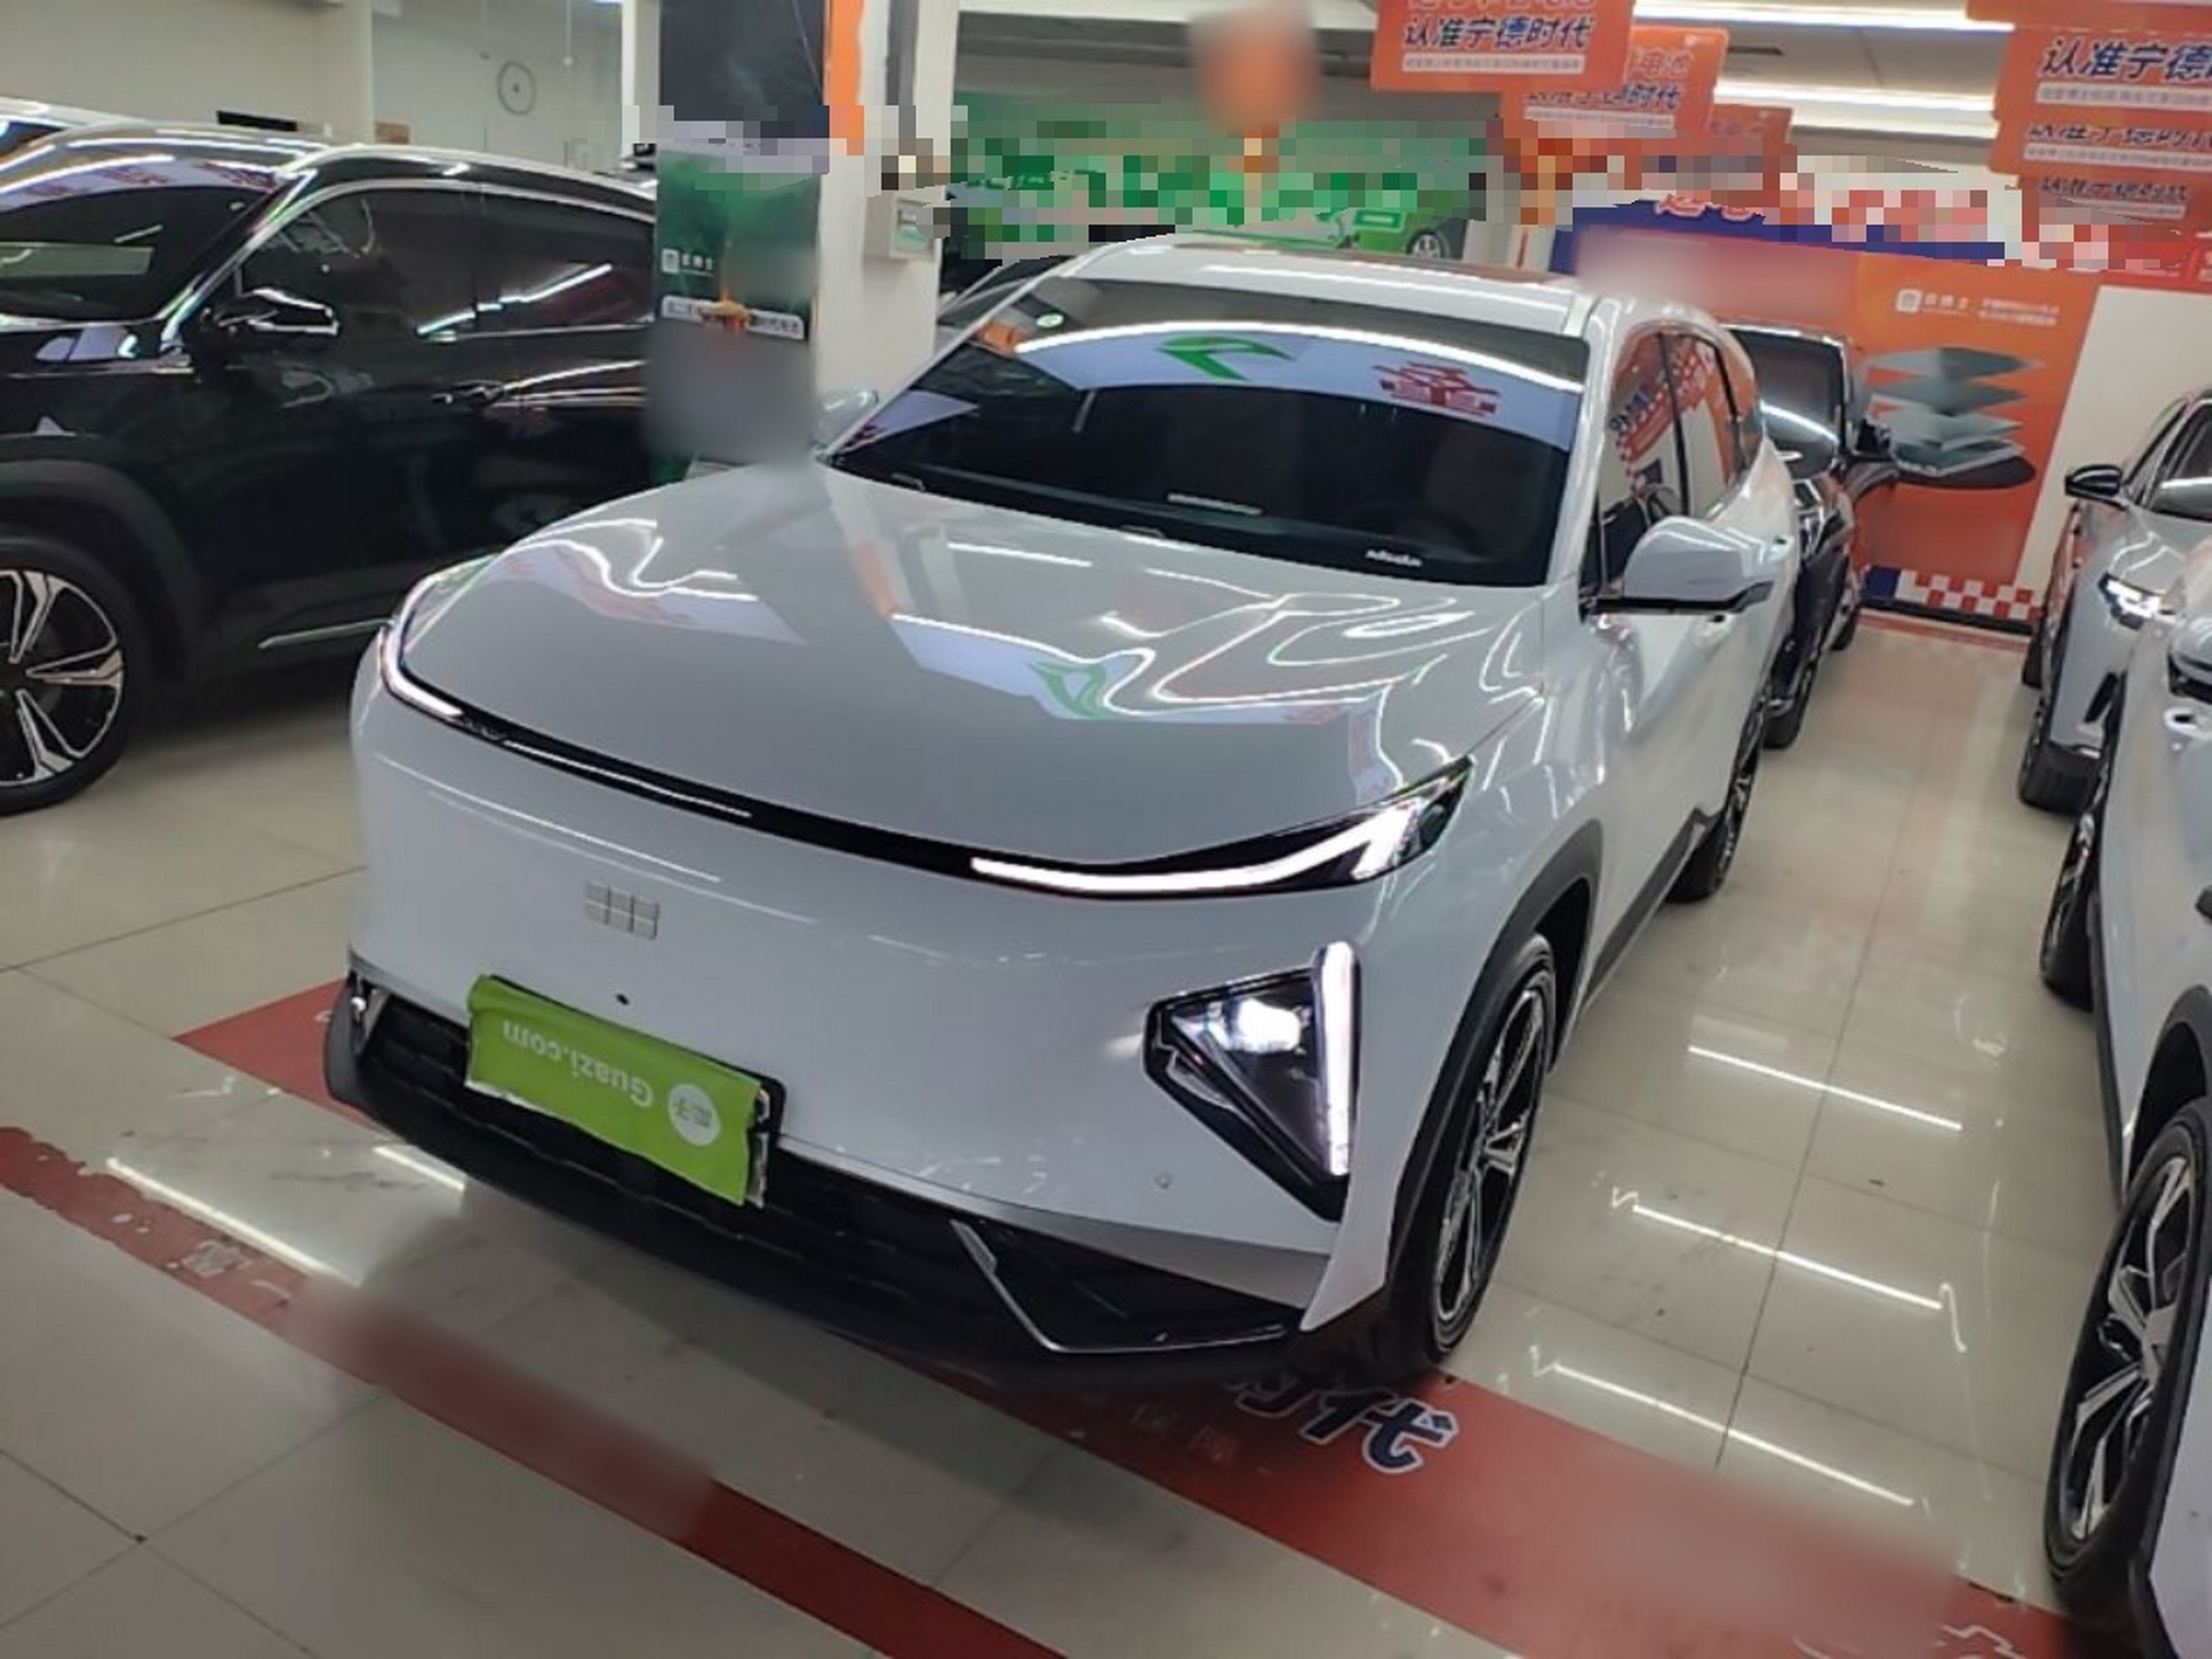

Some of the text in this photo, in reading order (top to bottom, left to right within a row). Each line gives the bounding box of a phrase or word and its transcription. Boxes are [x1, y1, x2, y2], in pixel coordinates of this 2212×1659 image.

[1404, 15, 1593, 50] 认准宁德时代
[502, 1020, 653, 1108] Guazi.com
